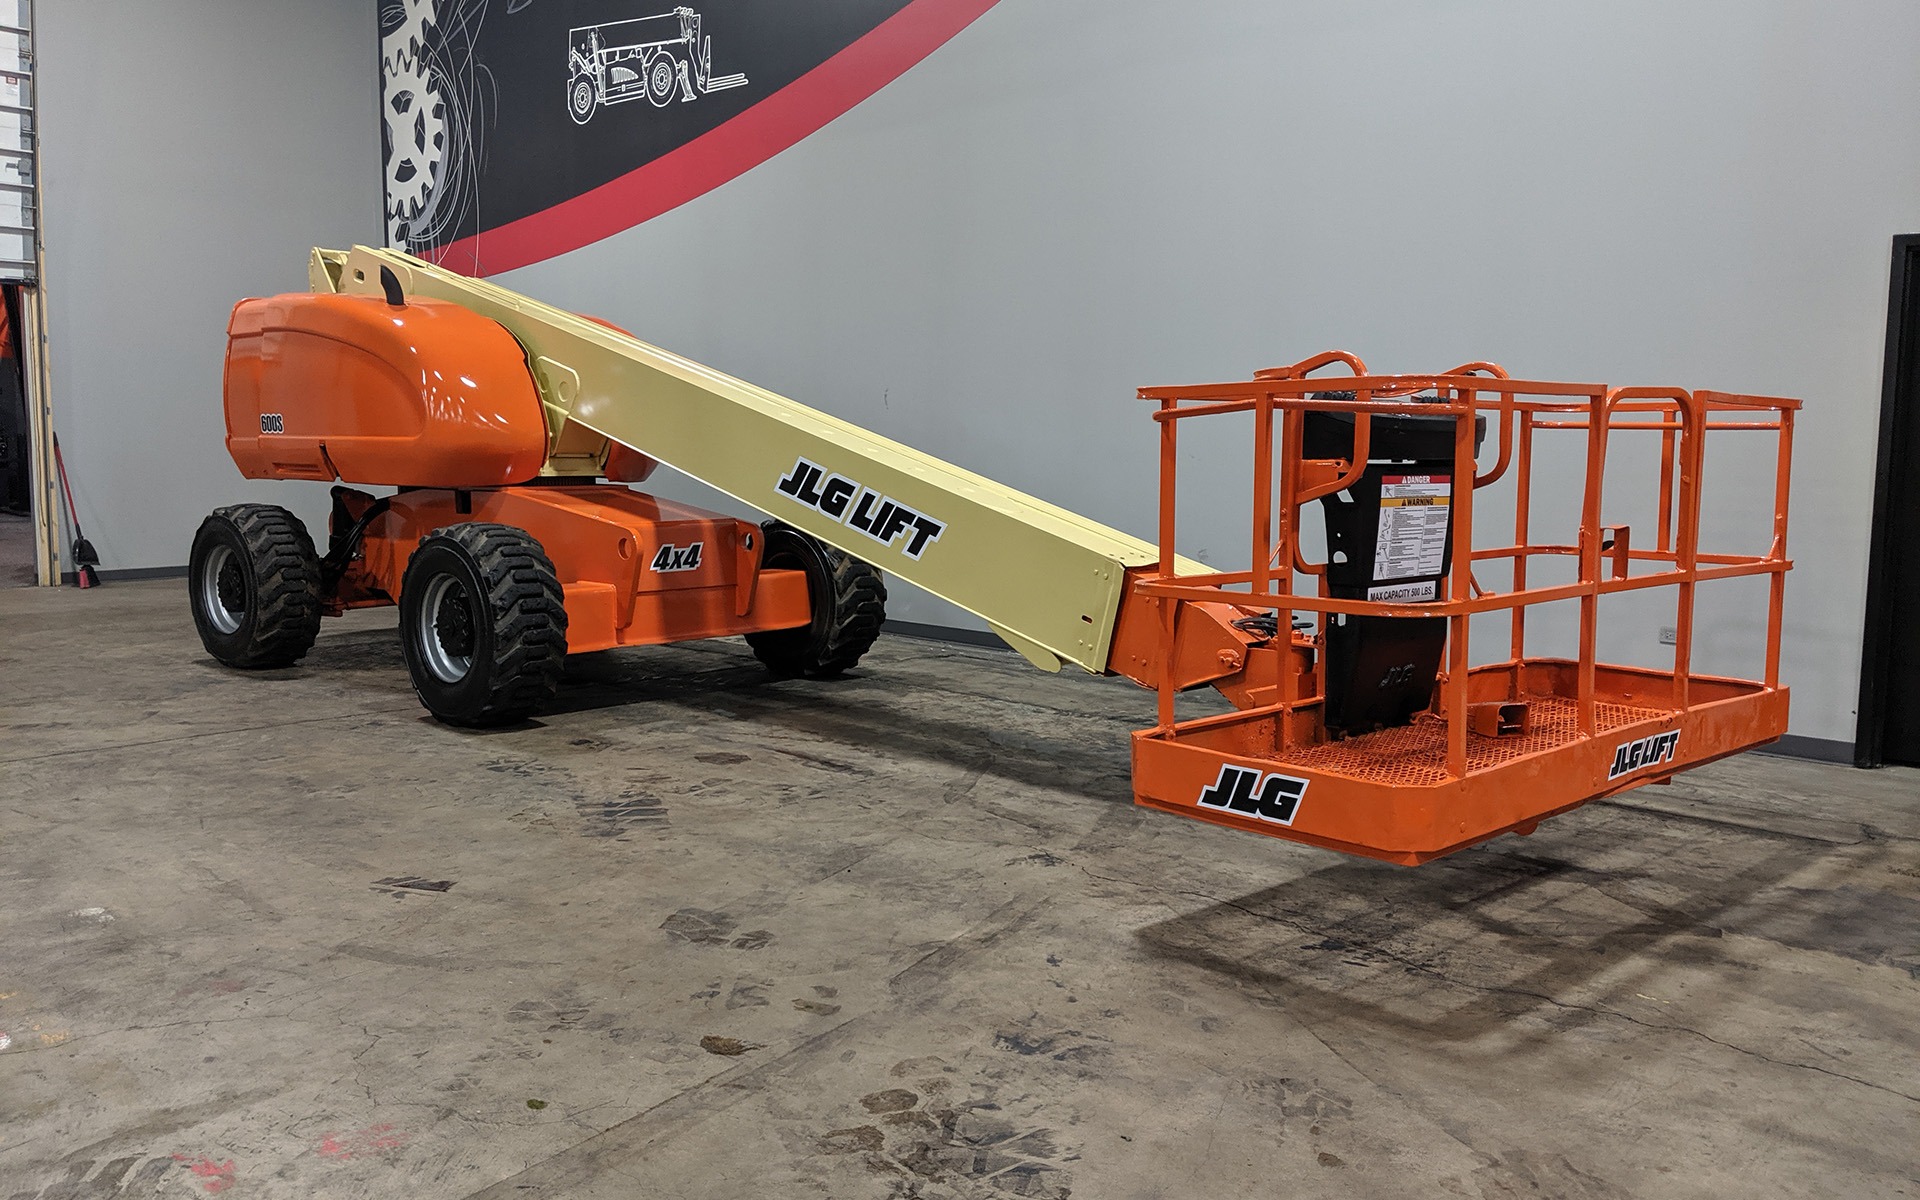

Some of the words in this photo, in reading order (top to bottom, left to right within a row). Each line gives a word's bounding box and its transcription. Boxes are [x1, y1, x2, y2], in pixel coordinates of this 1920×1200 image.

[260, 414, 284, 433] 600S
[1407, 475, 1431, 484] DANGER
[777, 459, 859, 520] JLG
[847, 490, 944, 558] LIFT
[1406, 498, 1434, 506] WARNING
[651, 543, 702, 571] 4x4
[1370, 592, 1384, 601] MAX
[1384, 588, 1410, 600] CAPACITY
[1411, 587, 1420, 597] 500
[1421, 586, 1433, 596] LBS.
[1609, 743, 1644, 778] JLG
[1639, 731, 1679, 767] LIFT
[1200, 766, 1306, 823] JLG
